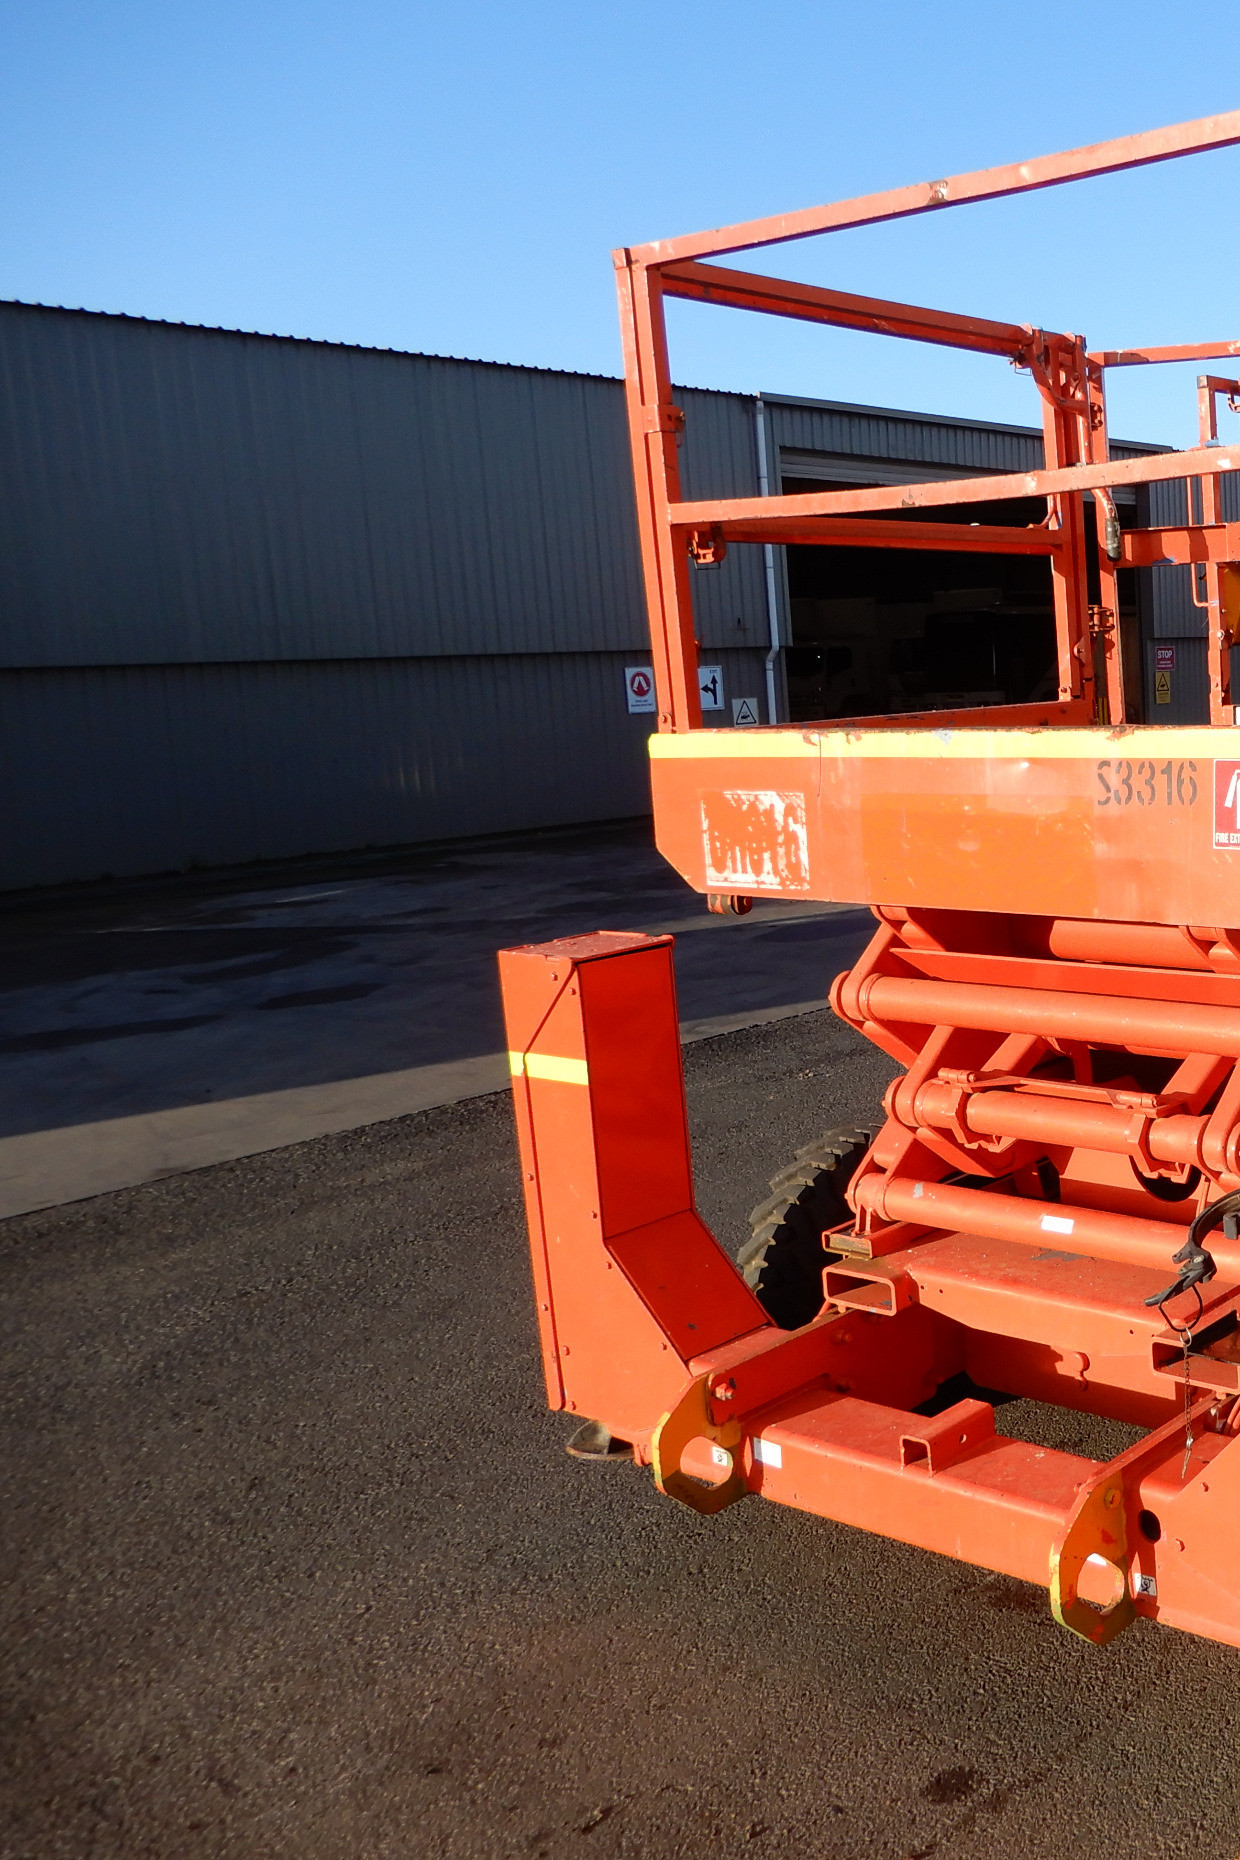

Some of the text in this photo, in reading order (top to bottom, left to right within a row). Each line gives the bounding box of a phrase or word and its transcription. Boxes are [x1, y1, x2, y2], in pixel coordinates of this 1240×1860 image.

[1157, 650, 1173, 659] STOP
[1096, 760, 1198, 806] S3316
[1215, 832, 1229, 844] FIRE
